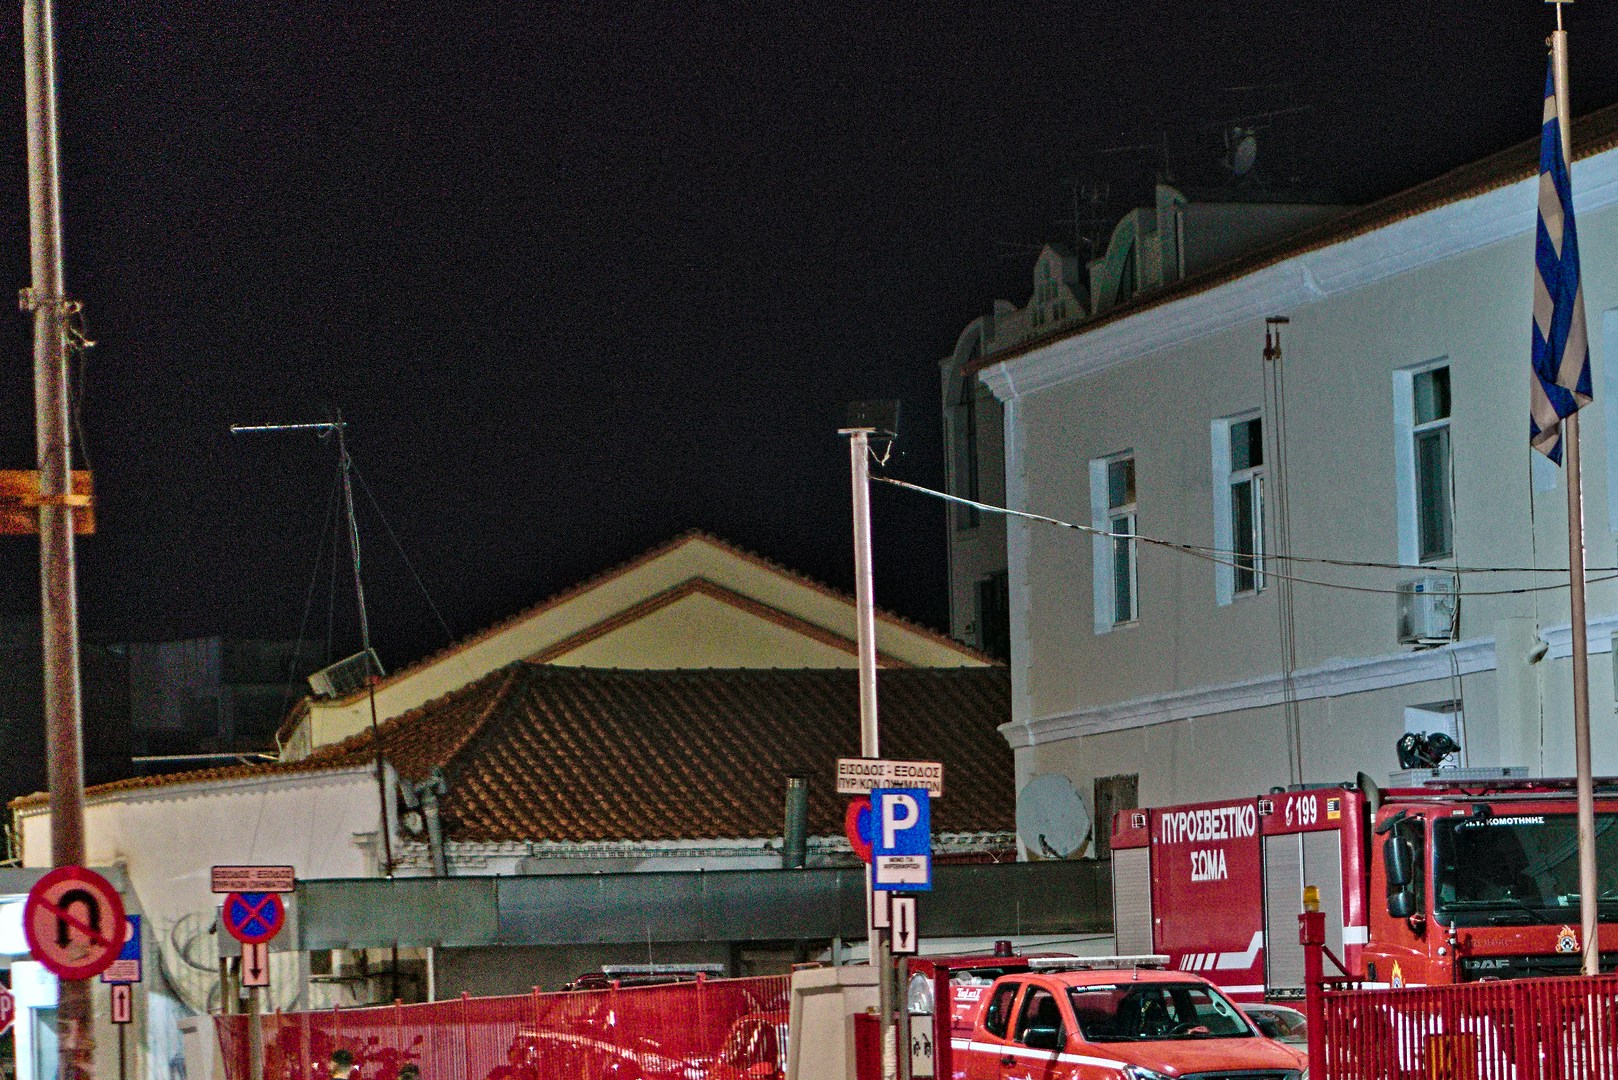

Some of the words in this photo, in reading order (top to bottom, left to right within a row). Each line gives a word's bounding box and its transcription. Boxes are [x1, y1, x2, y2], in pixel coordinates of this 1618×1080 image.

[840, 763, 885, 777] ΕΙΣΟΔΟΣ
[894, 765, 940, 779] ΕΞΟΔΟΣ
[882, 794, 919, 849] P
[1161, 804, 1256, 844] ΠΥΡΟΣΒΕΣΤΙΚΟ
[1296, 794, 1318, 825] 199
[1486, 816, 1545, 827] ΚΟΜΟΤΗΝΗΣ
[1190, 848, 1228, 882] ΣΩΜΑ
[1465, 959, 1510, 970] DAF
